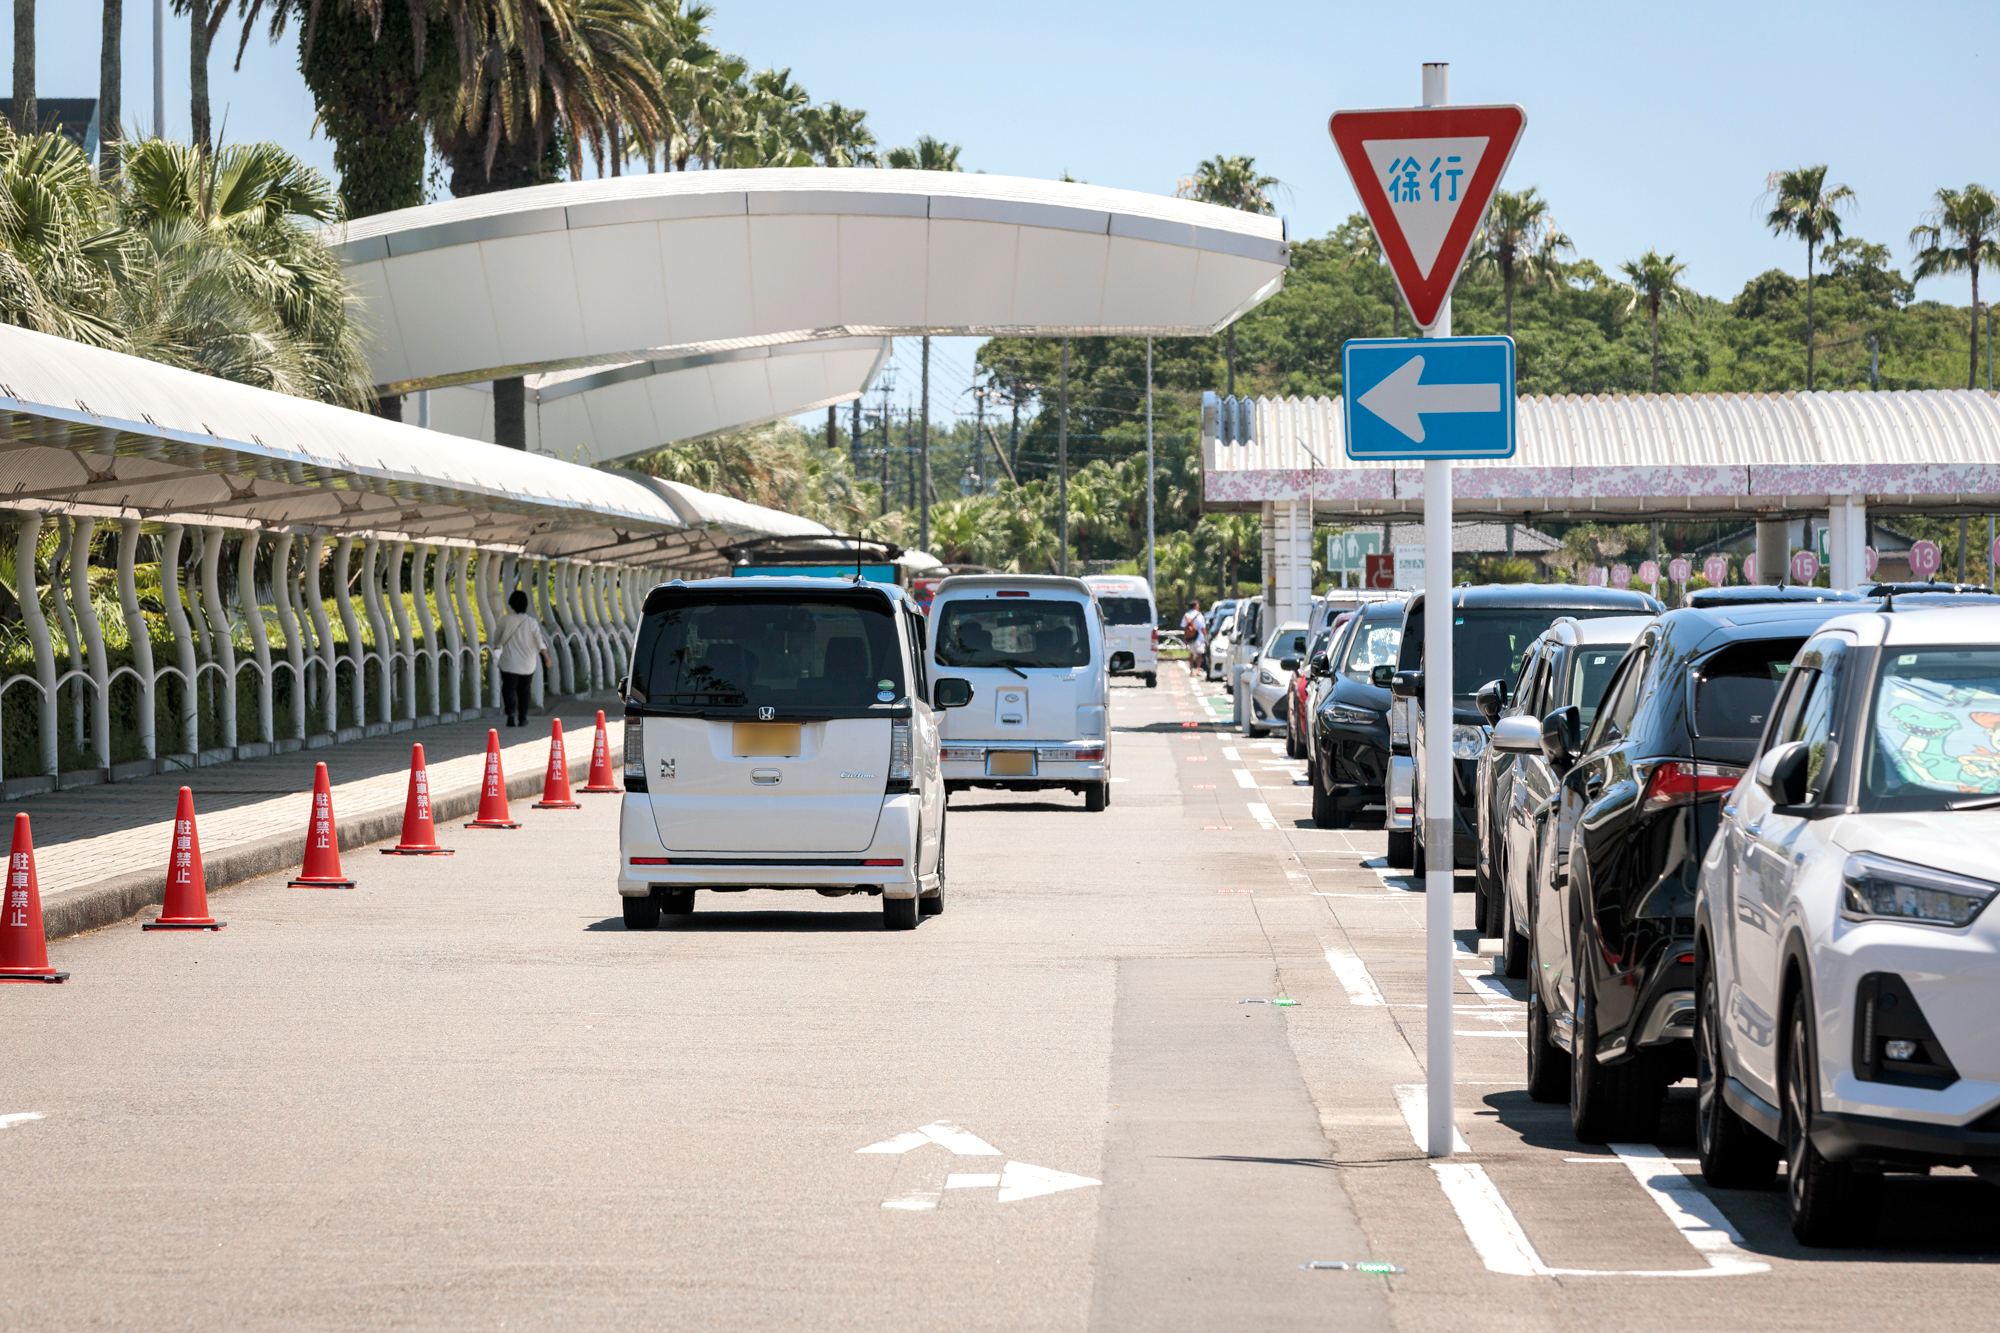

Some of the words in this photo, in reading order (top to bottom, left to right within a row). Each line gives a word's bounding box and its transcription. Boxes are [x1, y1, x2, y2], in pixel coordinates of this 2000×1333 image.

[1388, 156, 1464, 203] 徐行
[1614, 568, 1628, 583] 20
[1707, 562, 1722, 583] 17
[1795, 558, 1813, 576] 15
[1914, 548, 1934, 569] 13
[415, 770, 429, 820] 駐車禁止
[487, 752, 498, 797] 駐車禁止
[316, 793, 330, 849] 駐車禁止
[175, 820, 192, 883] 駐車禁止
[10, 852, 29, 927] 駐車禁止
